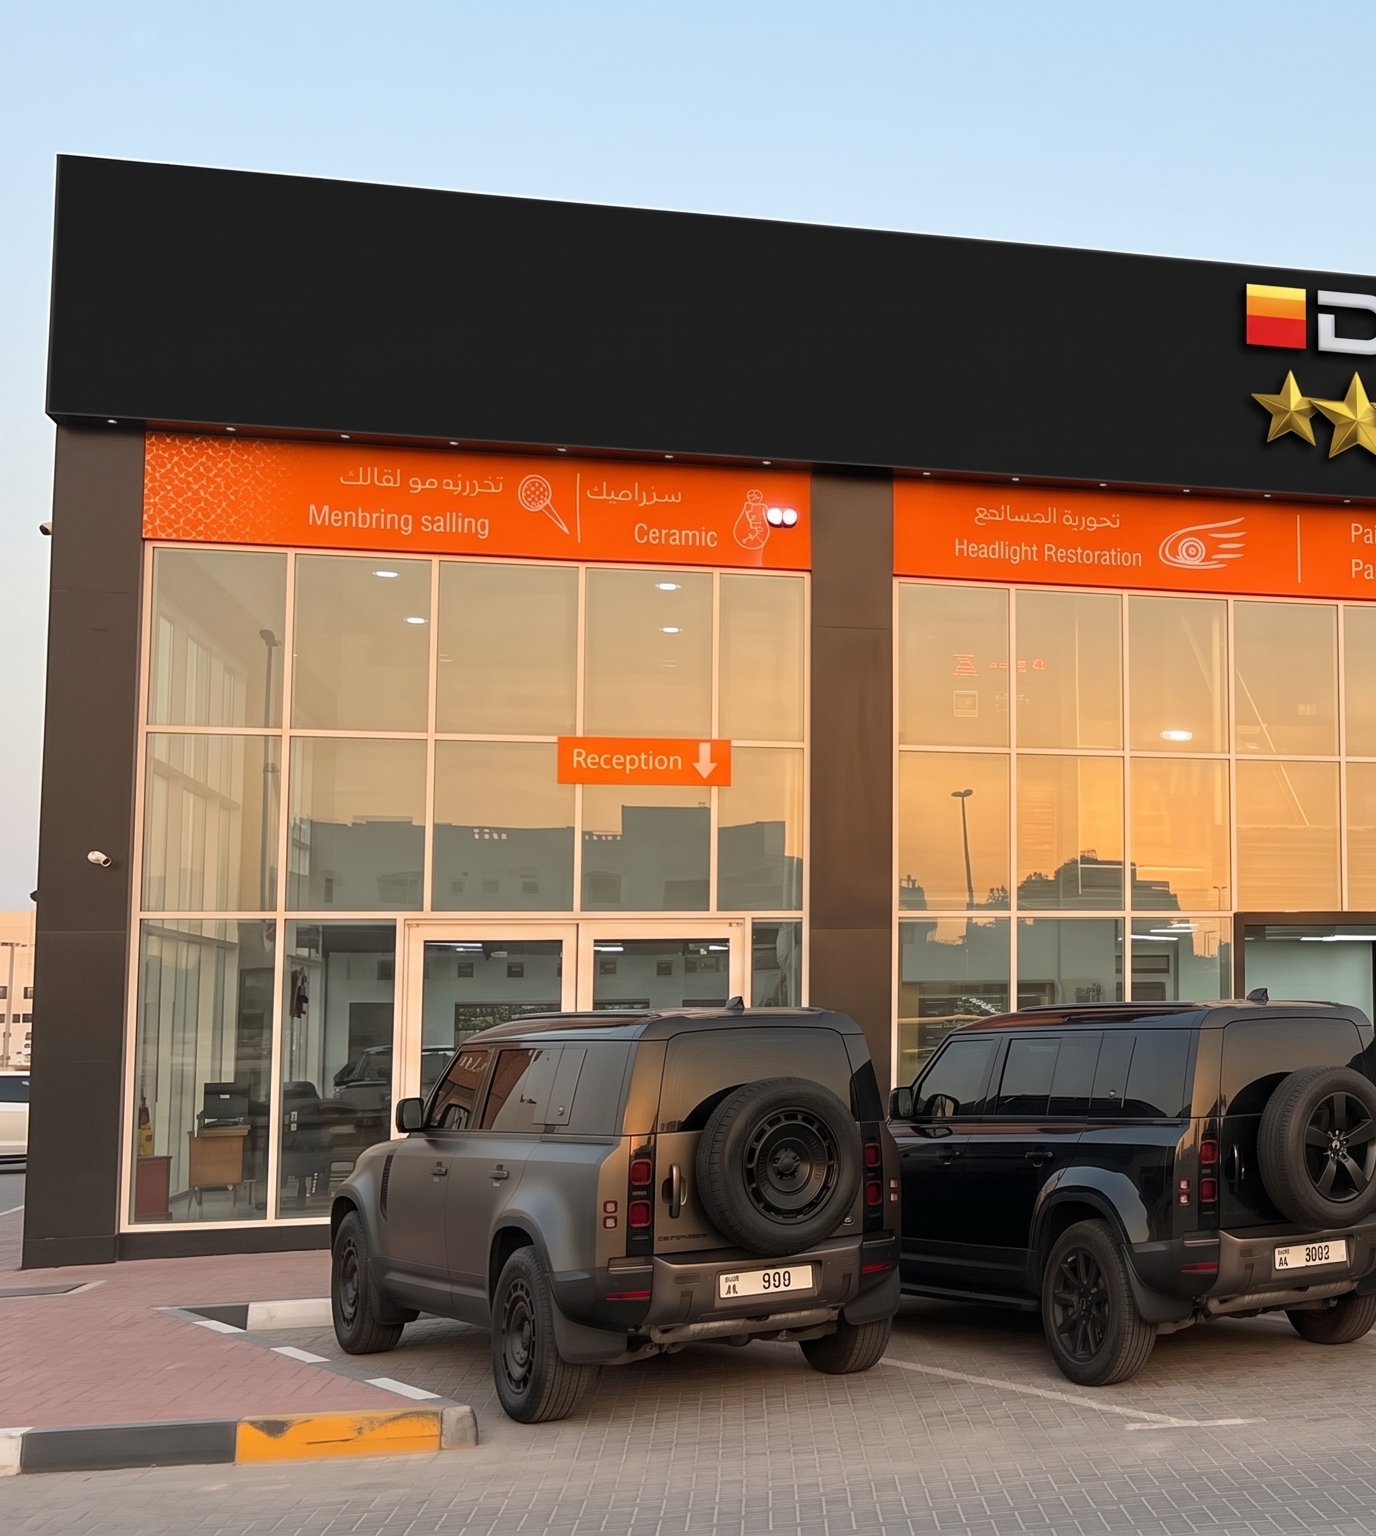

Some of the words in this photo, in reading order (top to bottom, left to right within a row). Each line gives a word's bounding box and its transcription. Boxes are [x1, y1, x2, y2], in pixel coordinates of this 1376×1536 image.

[308, 503, 413, 536] Menbring
[420, 511, 490, 540] salling
[634, 522, 718, 548] Ceramic
[954, 537, 1039, 565] Headlight
[1044, 543, 1142, 567] Restoration
[572, 748, 682, 775] Reception
